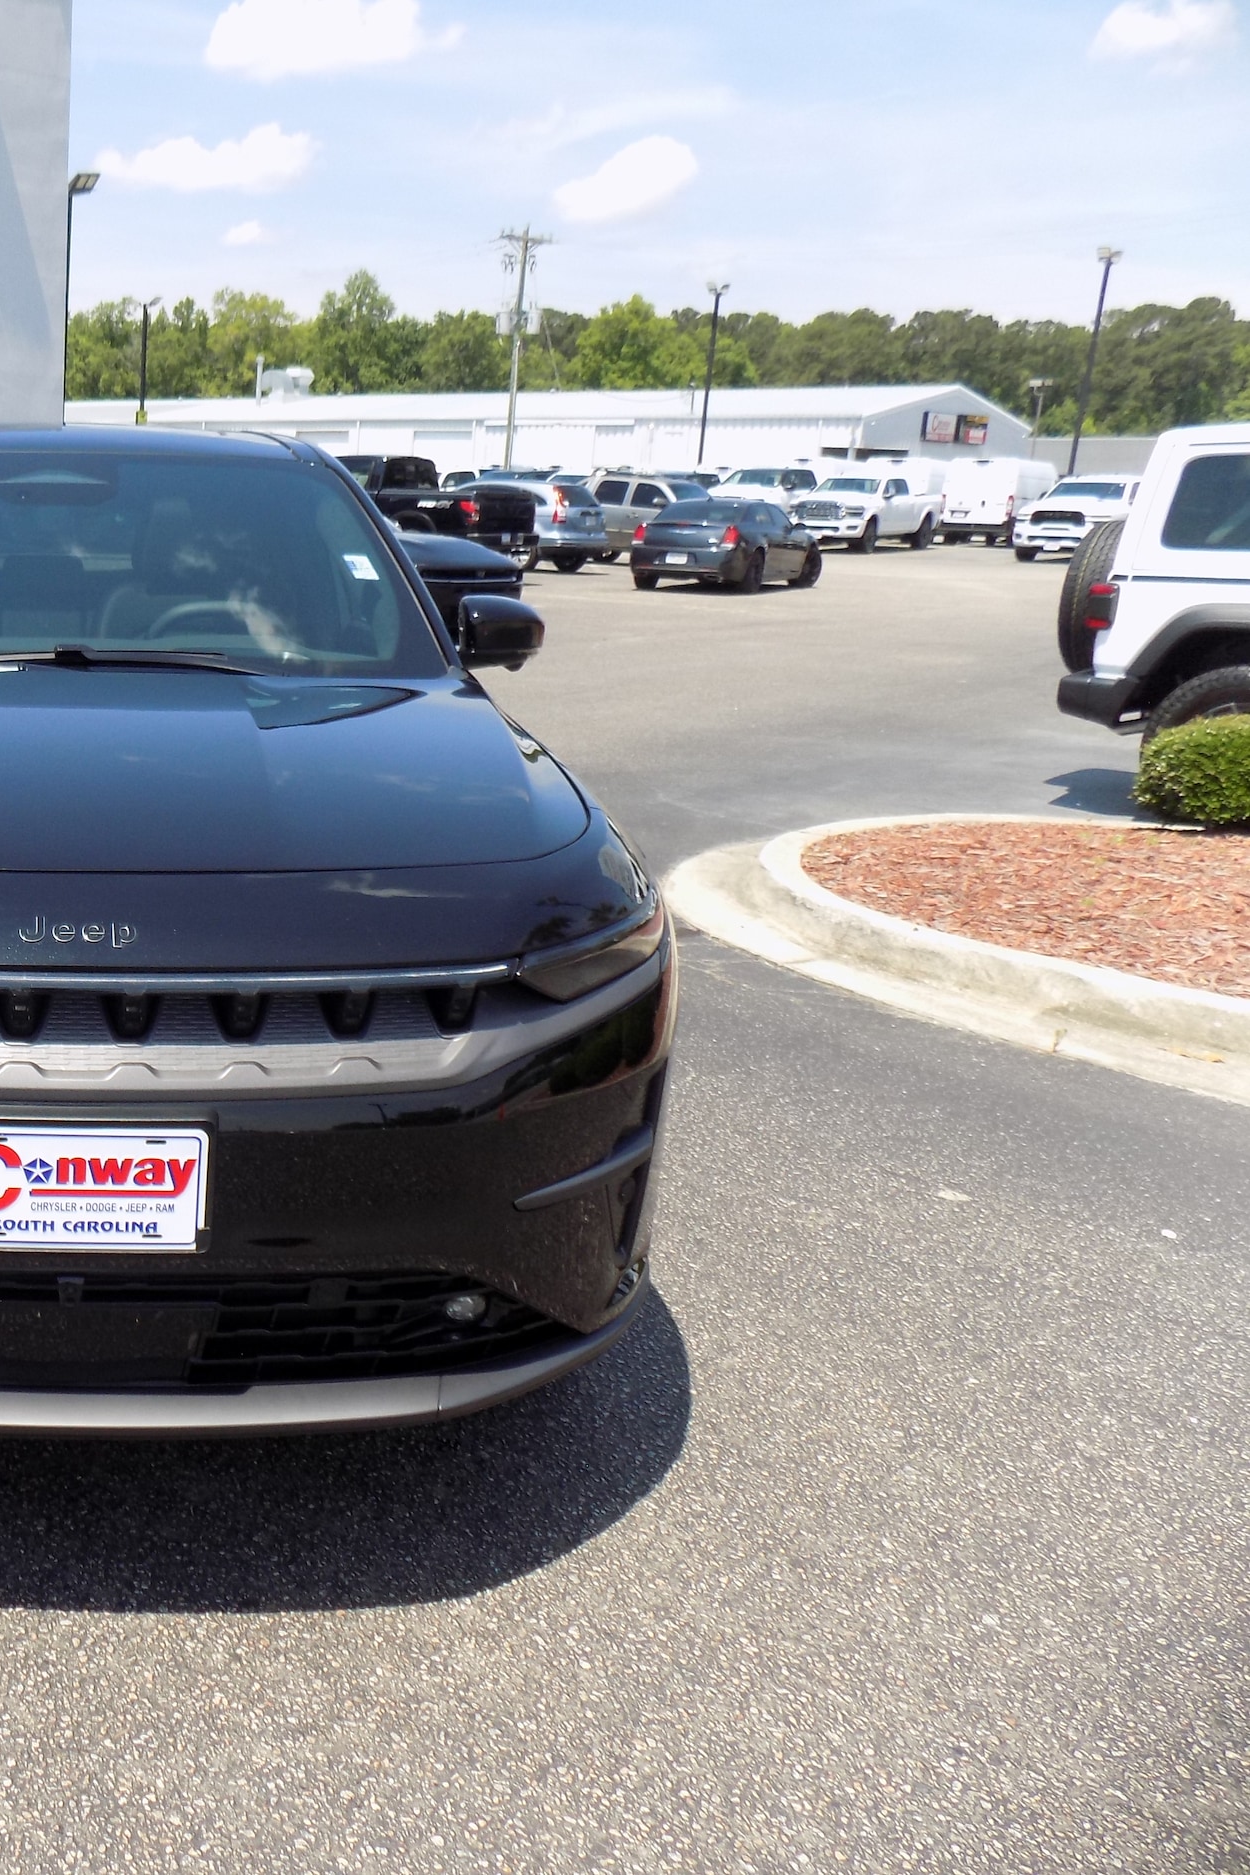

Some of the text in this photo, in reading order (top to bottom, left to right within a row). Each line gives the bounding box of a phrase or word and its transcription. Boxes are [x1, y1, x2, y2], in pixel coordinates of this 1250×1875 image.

[18, 915, 137, 949] Jeep
[30, 1202, 175, 1213] CHRYSLER DODGE JEEP RAM
[63, 1220, 158, 1234] CAROLINA
